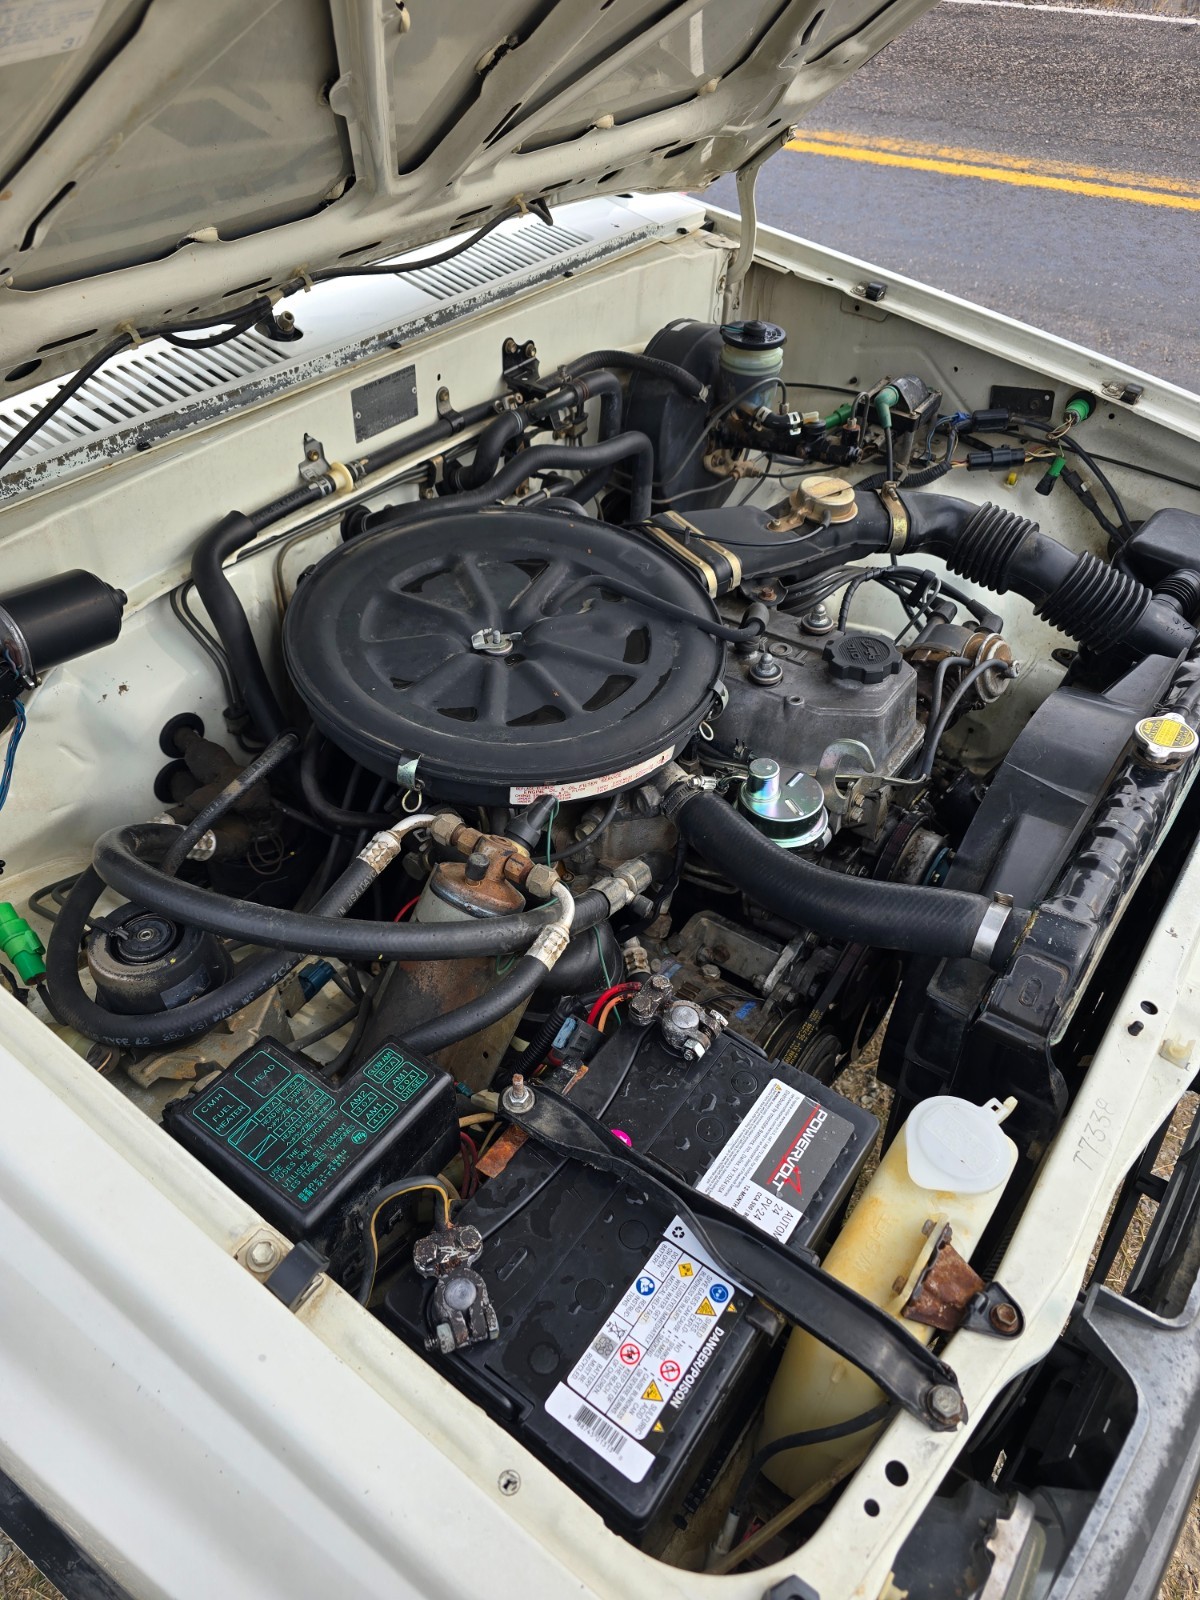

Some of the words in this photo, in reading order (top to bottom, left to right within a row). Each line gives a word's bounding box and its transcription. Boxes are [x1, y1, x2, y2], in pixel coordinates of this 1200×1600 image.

[846, 643, 861, 660] OIL
[345, 888, 362, 906] USA
[251, 1062, 276, 1086] HEAD
[390, 1068, 409, 1086] AM1
[401, 1074, 425, 1098] DIESEL
[348, 1089, 367, 1108] AM2
[355, 1094, 374, 1112] 30A
[774, 1089, 790, 1109] Distributed
[211, 1100, 234, 1123] FUEL
[215, 1103, 245, 1132] HEATER
[363, 1102, 382, 1119] AM1
[268, 1164, 283, 1178] USE
[285, 1147, 300, 1160] THE
[300, 1108, 339, 1146] DESIGNATED
[768, 1109, 829, 1191] POWERVOLT
[281, 1160, 310, 1188] UTILISEZ
[311, 1122, 348, 1157] SEULEMENT
[274, 1160, 296, 1182] FUSES
[286, 1178, 301, 1192] LES
[300, 1152, 327, 1178] FUSIBLES
[723, 1172, 734, 1184] 75254
[717, 1183, 726, 1193] USA
[753, 1191, 762, 1201] CCA
[752, 1196, 773, 1220] PV-24
[770, 1203, 783, 1215] 24
[664, 1247, 672, 1255] OR
[670, 1251, 678, 1259] DO
[655, 1254, 667, 1268] OPEN
[663, 1258, 673, 1269] NOT
[658, 1268, 666, 1277] TIP
[700, 1274, 712, 1288] SIVE
[657, 1273, 675, 1296] MEDICAL
[668, 1277, 681, 1292] WITH
[672, 1281, 687, 1299] FLUSH
[688, 1270, 707, 1295] BLINDNESS
[648, 1296, 660, 1310] HELP
[664, 1297, 677, 1312] EYES
[682, 1292, 692, 1302] OR
[689, 1286, 705, 1306] GASES
[634, 1298, 646, 1313] READ
[650, 1307, 662, 1320] GET
[681, 1304, 693, 1317] CAN
[642, 1309, 668, 1344] IMMEDIATELY
[672, 1315, 685, 1332] CAUSE
[694, 1316, 712, 1338] SHIELD
[645, 1332, 664, 1357] SMOKING
[653, 1336, 670, 1358] FLAMES
[658, 1340, 675, 1361] SPARKS
[672, 1342, 683, 1353] NO
[583, 1358, 596, 1374] MUST
[610, 1358, 618, 1367] OF
[614, 1363, 625, 1375] THE
[668, 1326, 726, 1408] DANGER/POISON
[577, 1373, 586, 1383] BE
[584, 1363, 603, 1388] BATTERY
[618, 1367, 631, 1381] KEEP
[634, 1367, 643, 1377] OR
[601, 1374, 617, 1394] REACH
[610, 1380, 622, 1393] OUT
[621, 1375, 638, 1396] SEVERE
[634, 1372, 649, 1391] CAUSE
[605, 1392, 615, 1402] OF
[615, 1389, 638, 1419] BLINDNESS
[628, 1401, 640, 1416] CAN
[634, 1402, 649, 1419] ACID
[633, 1403, 657, 1435] SULFURIC
